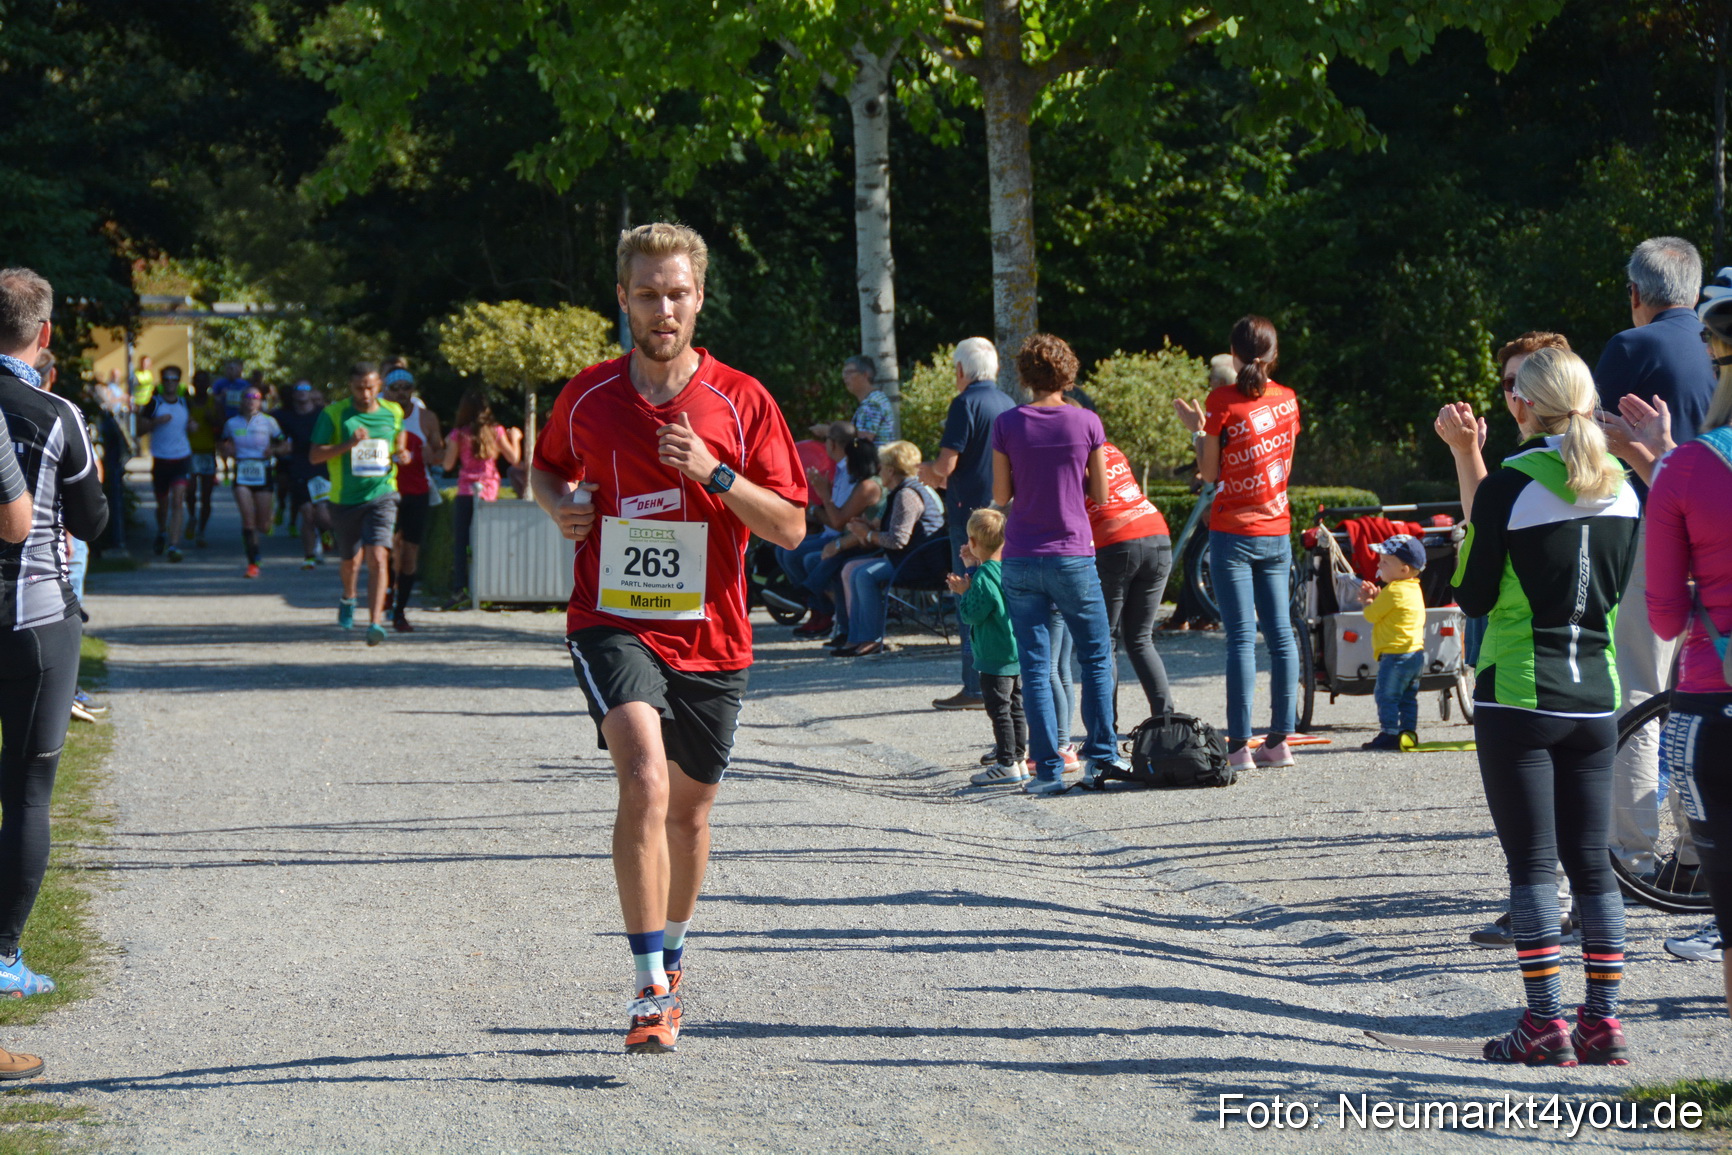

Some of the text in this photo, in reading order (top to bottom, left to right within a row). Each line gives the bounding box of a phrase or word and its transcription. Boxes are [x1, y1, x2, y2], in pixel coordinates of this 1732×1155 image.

[356, 448, 383, 461] 2640
[637, 498, 664, 511] DEHN
[629, 527, 676, 540] BOCK
[624, 546, 680, 578] 263
[620, 580, 642, 588] PARTL
[630, 594, 671, 608] Martin
[1673, 713, 1692, 767] ROTHSEE
